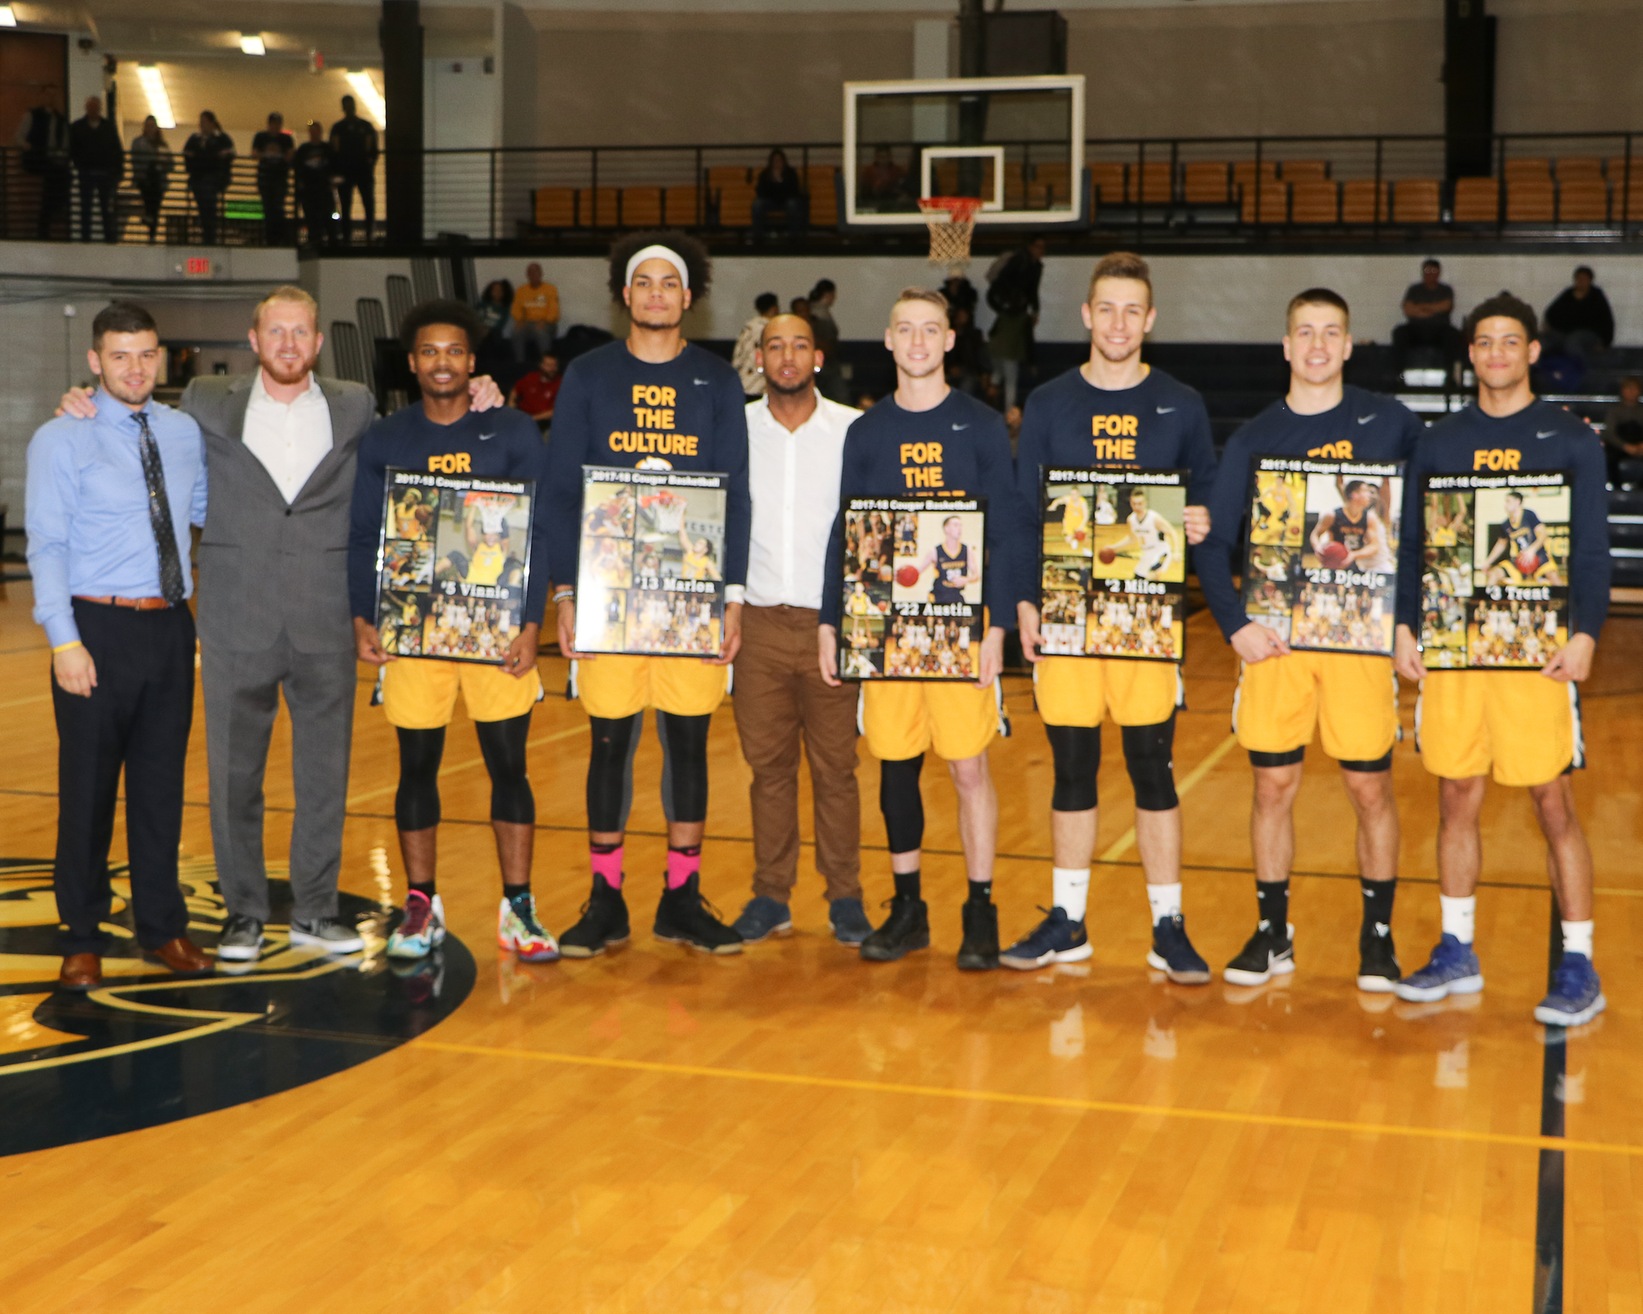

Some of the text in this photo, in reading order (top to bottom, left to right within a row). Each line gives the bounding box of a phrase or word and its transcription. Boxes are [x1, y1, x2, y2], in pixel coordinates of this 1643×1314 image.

[631, 384, 677, 407] FOR
[633, 407, 675, 430] THE
[1091, 414, 1139, 437] FOR
[608, 431, 699, 456] CULTURE
[1092, 438, 1136, 460] THE
[900, 442, 943, 464] FOR
[1472, 449, 1522, 471] FOR
[428, 452, 472, 474] FOR
[1302, 460, 1340, 474] Cougar
[1340, 462, 1396, 475] Basketball
[435, 476, 472, 491] Cougar
[472, 479, 525, 494] Basketball
[632, 473, 668, 487] Cougar
[668, 475, 720, 488] Basketball
[901, 466, 944, 488] THE
[1089, 471, 1125, 484] Cougar
[1126, 472, 1180, 485] Basketball
[1470, 475, 1507, 489] Cougar
[1507, 474, 1563, 487] Basketball
[889, 500, 925, 512] Cougar
[925, 499, 977, 511] Basketball
[460, 582, 510, 600] Vinnie
[1123, 579, 1166, 595] Milos
[1505, 586, 1550, 600] Trent
[922, 602, 973, 617] Austin
